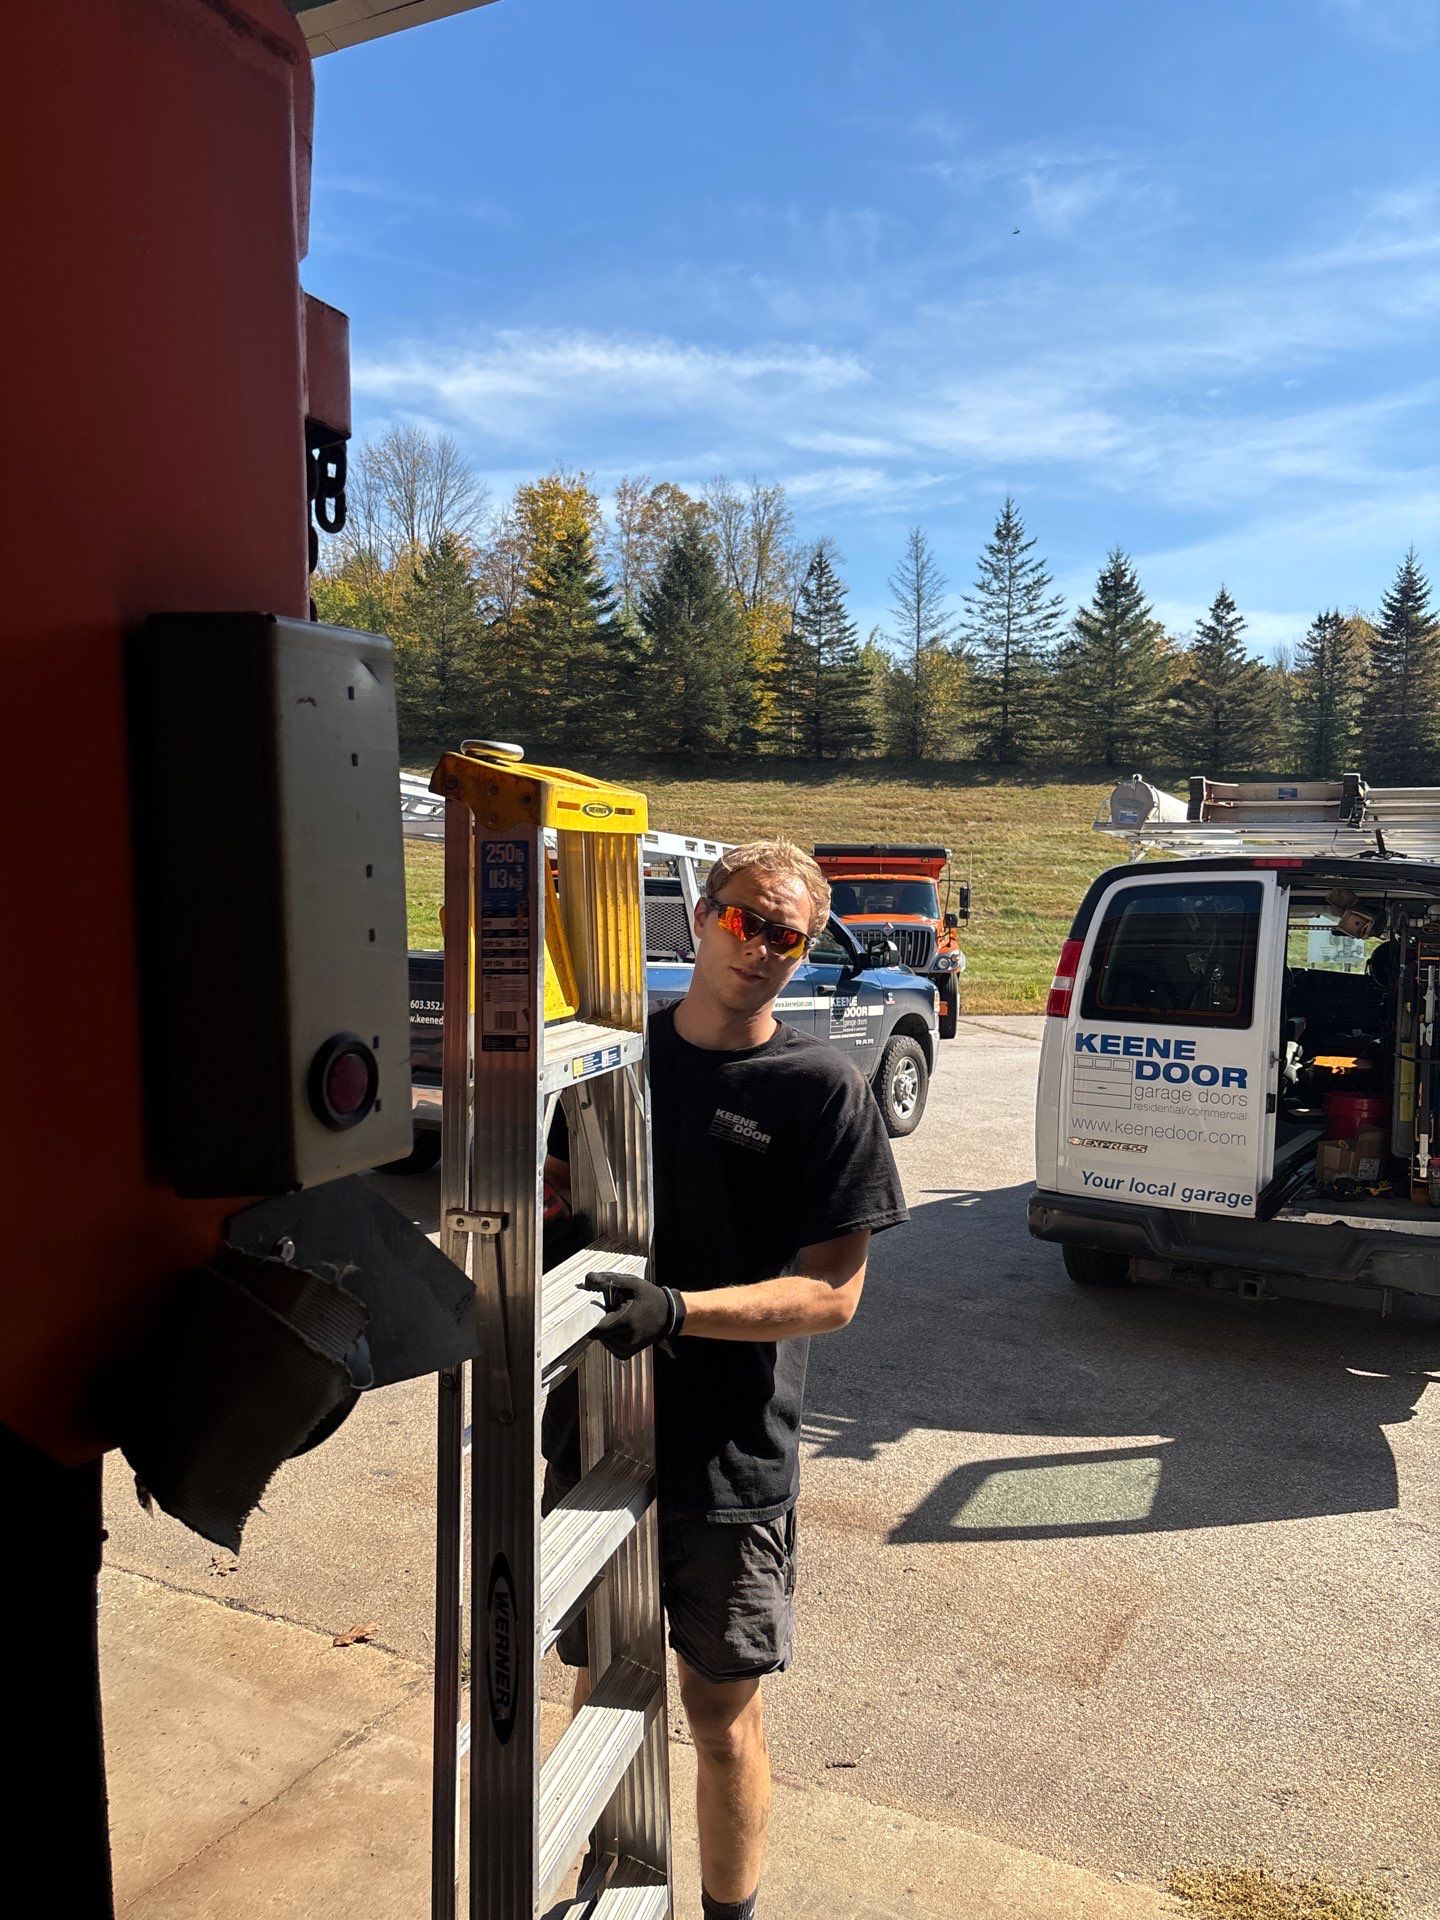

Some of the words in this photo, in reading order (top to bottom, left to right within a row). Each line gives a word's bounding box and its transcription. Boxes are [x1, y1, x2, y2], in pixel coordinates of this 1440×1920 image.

[830, 996, 858, 1007] KEENE
[844, 1006, 868, 1018] DOOR
[855, 1038, 874, 1047] RAM
[1075, 1032, 1197, 1061] KEENE
[1135, 1060, 1248, 1089] DOOR
[1134, 1085, 1192, 1105] garage
[1198, 1088, 1248, 1107] doors
[715, 1108, 759, 1130] KEENE
[1133, 1101, 1248, 1120] residential/commercial
[733, 1123, 771, 1144] DOOR
[1071, 1117, 1246, 1146] www.keenedoor.com
[1082, 1138, 1148, 1153] EXPRESS
[1082, 1170, 1124, 1191] Your
[1129, 1177, 1176, 1198] local
[1180, 1187, 1253, 1209] garage
[494, 1591, 511, 1708] WERNER
